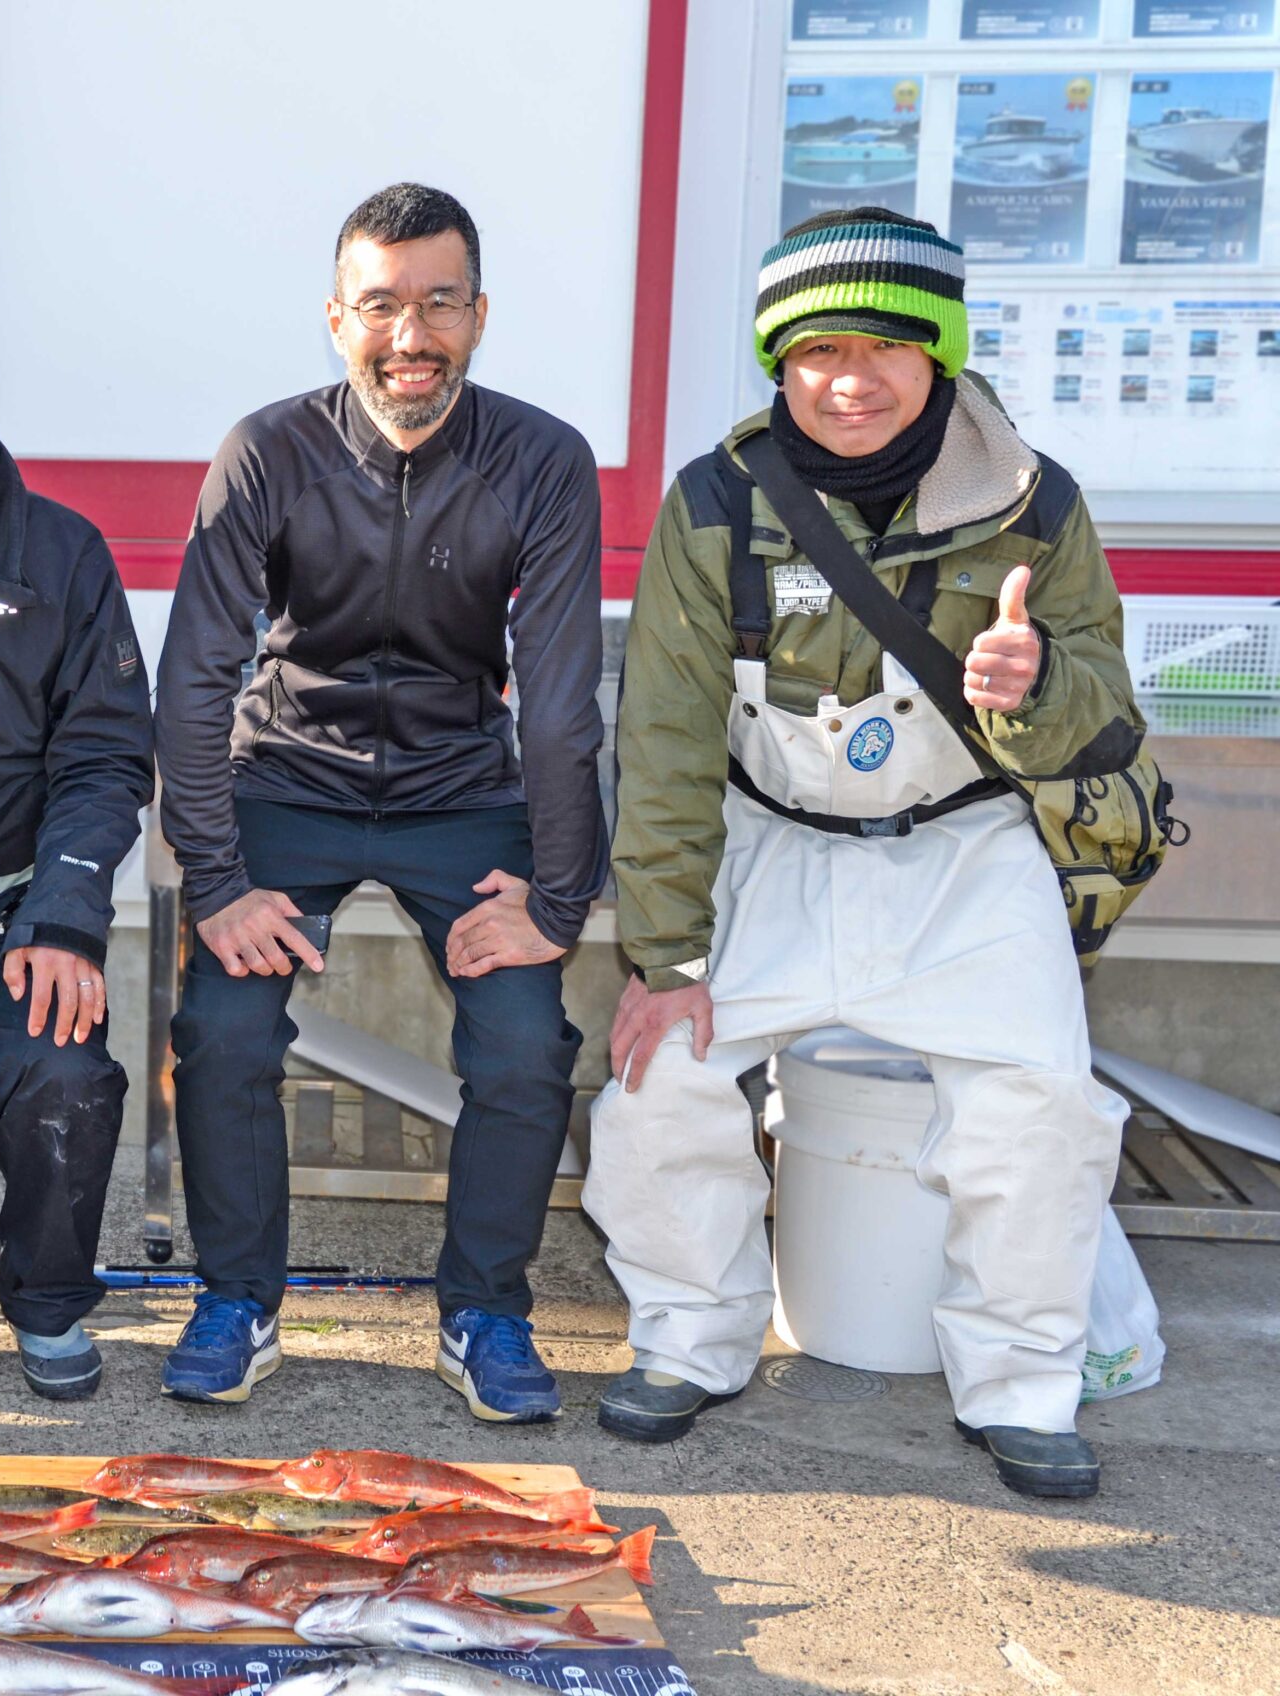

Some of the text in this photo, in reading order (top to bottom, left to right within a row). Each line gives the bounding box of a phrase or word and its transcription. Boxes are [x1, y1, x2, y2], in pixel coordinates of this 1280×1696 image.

[464, 1650, 542, 1662] MARINA
[145, 1662, 158, 1670] 40
[198, 1662, 211, 1670] 45
[619, 1667, 634, 1675] 85
